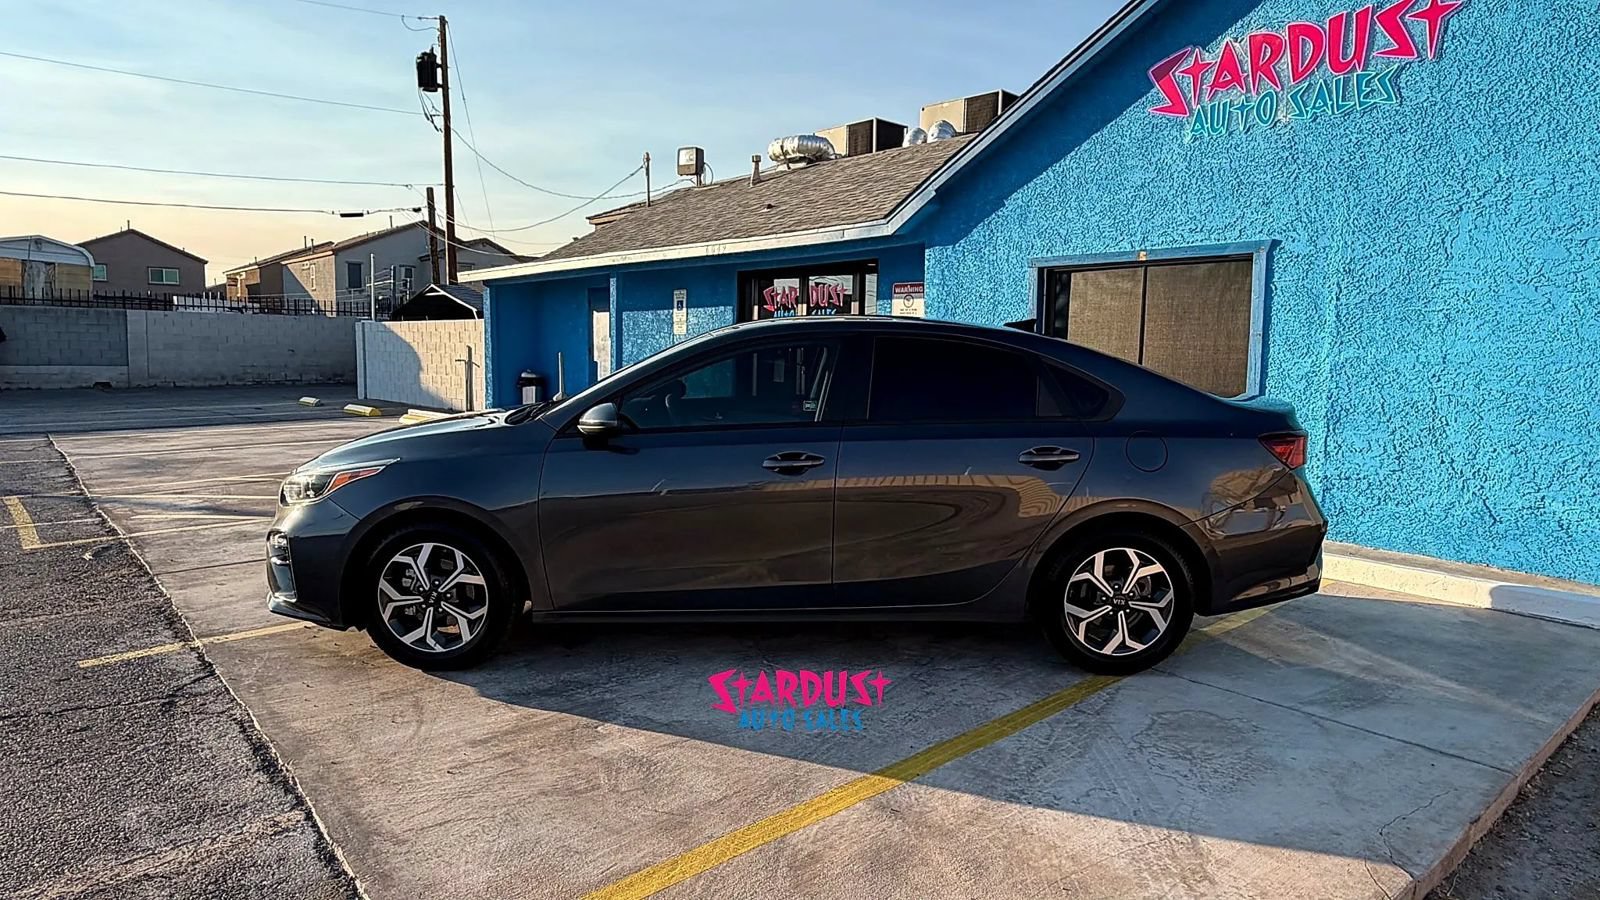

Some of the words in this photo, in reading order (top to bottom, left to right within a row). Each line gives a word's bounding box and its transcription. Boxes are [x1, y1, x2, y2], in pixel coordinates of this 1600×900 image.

[1148, 0, 1462, 117] STARDUST
[1187, 90, 1277, 142] AUTO
[1287, 64, 1399, 120] SALES
[763, 285, 798, 311] STAR
[808, 282, 848, 307] DUST
[894, 285, 923, 293] WARNING
